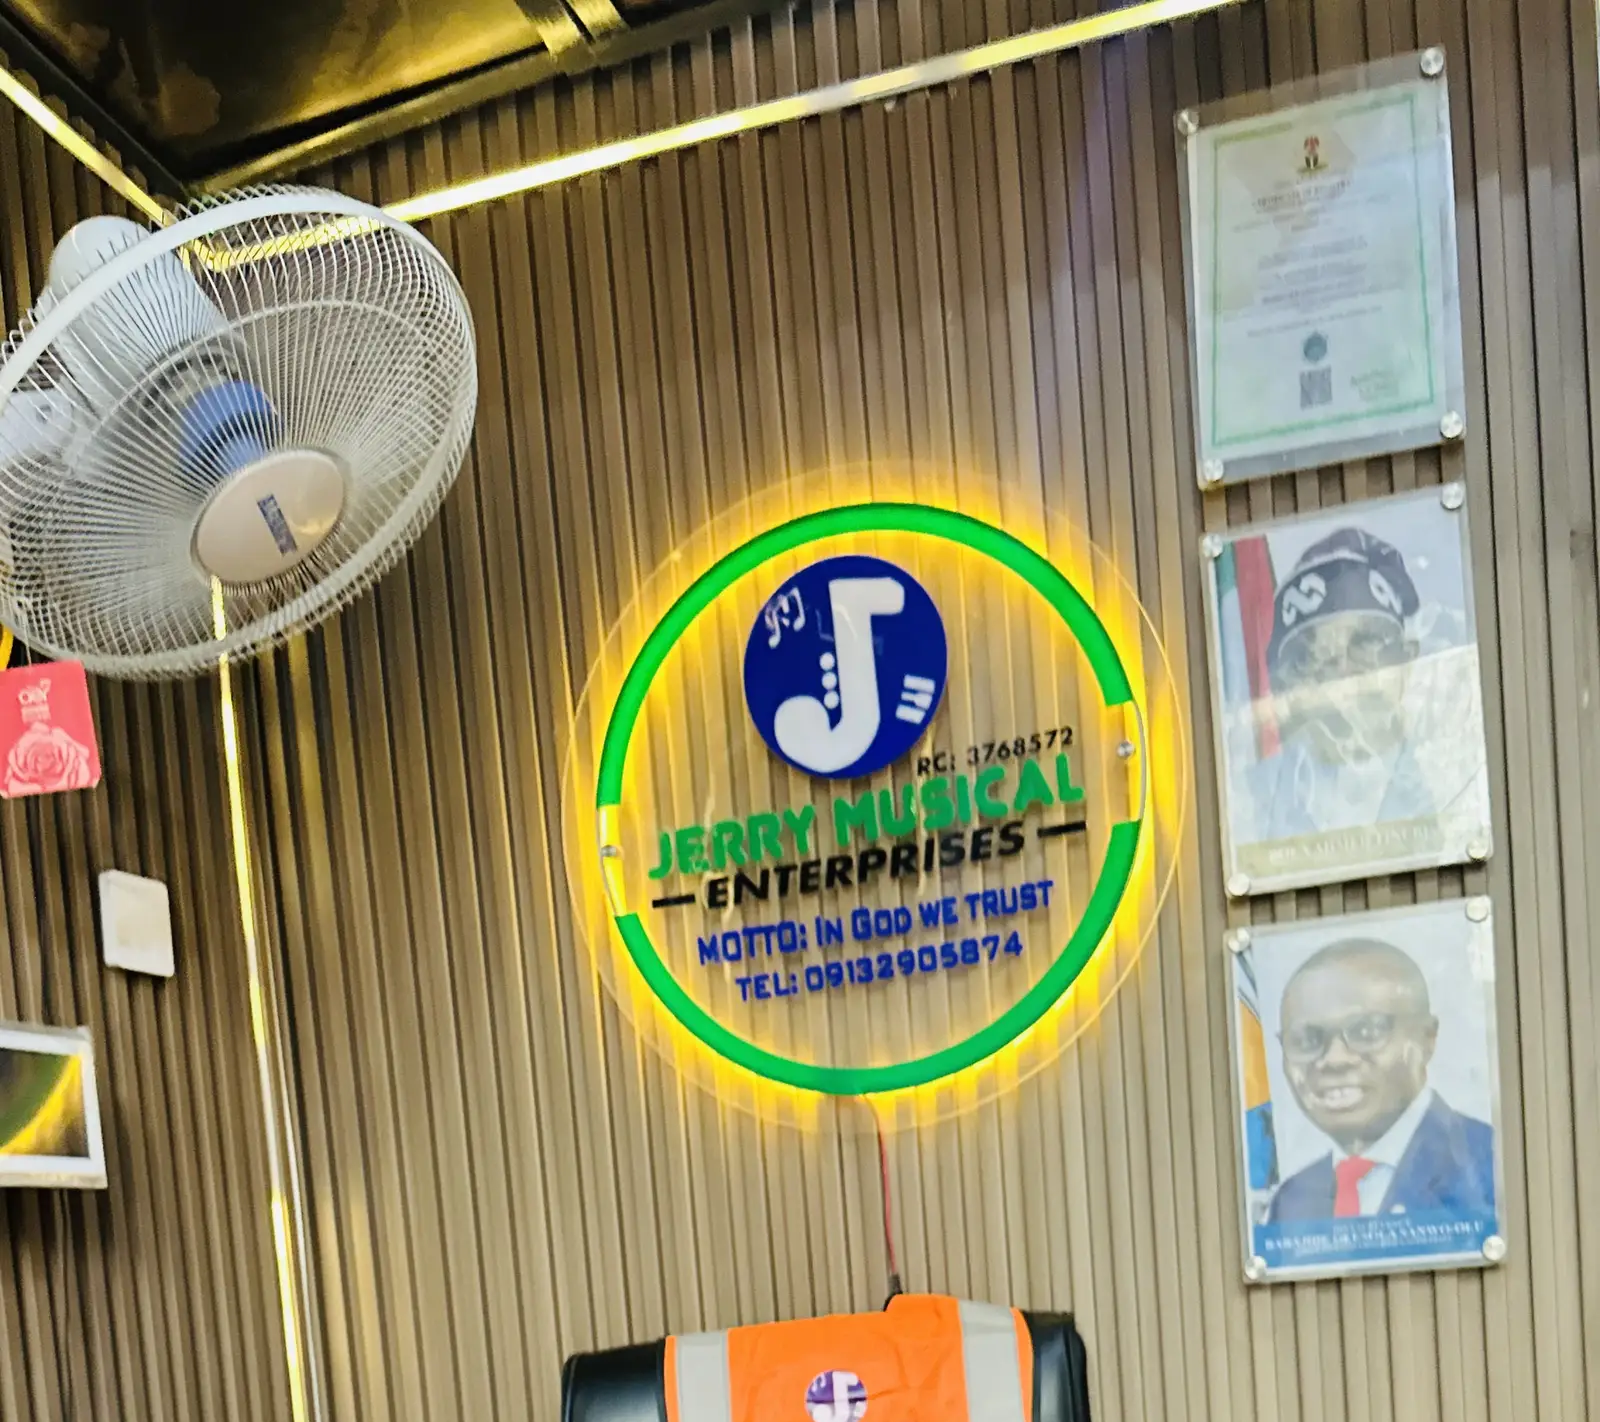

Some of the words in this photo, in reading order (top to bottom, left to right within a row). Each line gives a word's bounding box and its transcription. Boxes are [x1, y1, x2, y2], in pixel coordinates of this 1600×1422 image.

[916, 752, 956, 776] RC:
[967, 726, 1074, 766] 3768572
[648, 804, 816, 880] JERRY
[833, 752, 1085, 847] MUSICAL
[707, 821, 1025, 909] ENTERPRISES
[697, 920, 808, 965] MOTTO:
[918, 897, 959, 928] WE
[964, 880, 1054, 921] TRUST
[735, 972, 799, 1002] TEL:
[804, 930, 1024, 992] 09132905874
